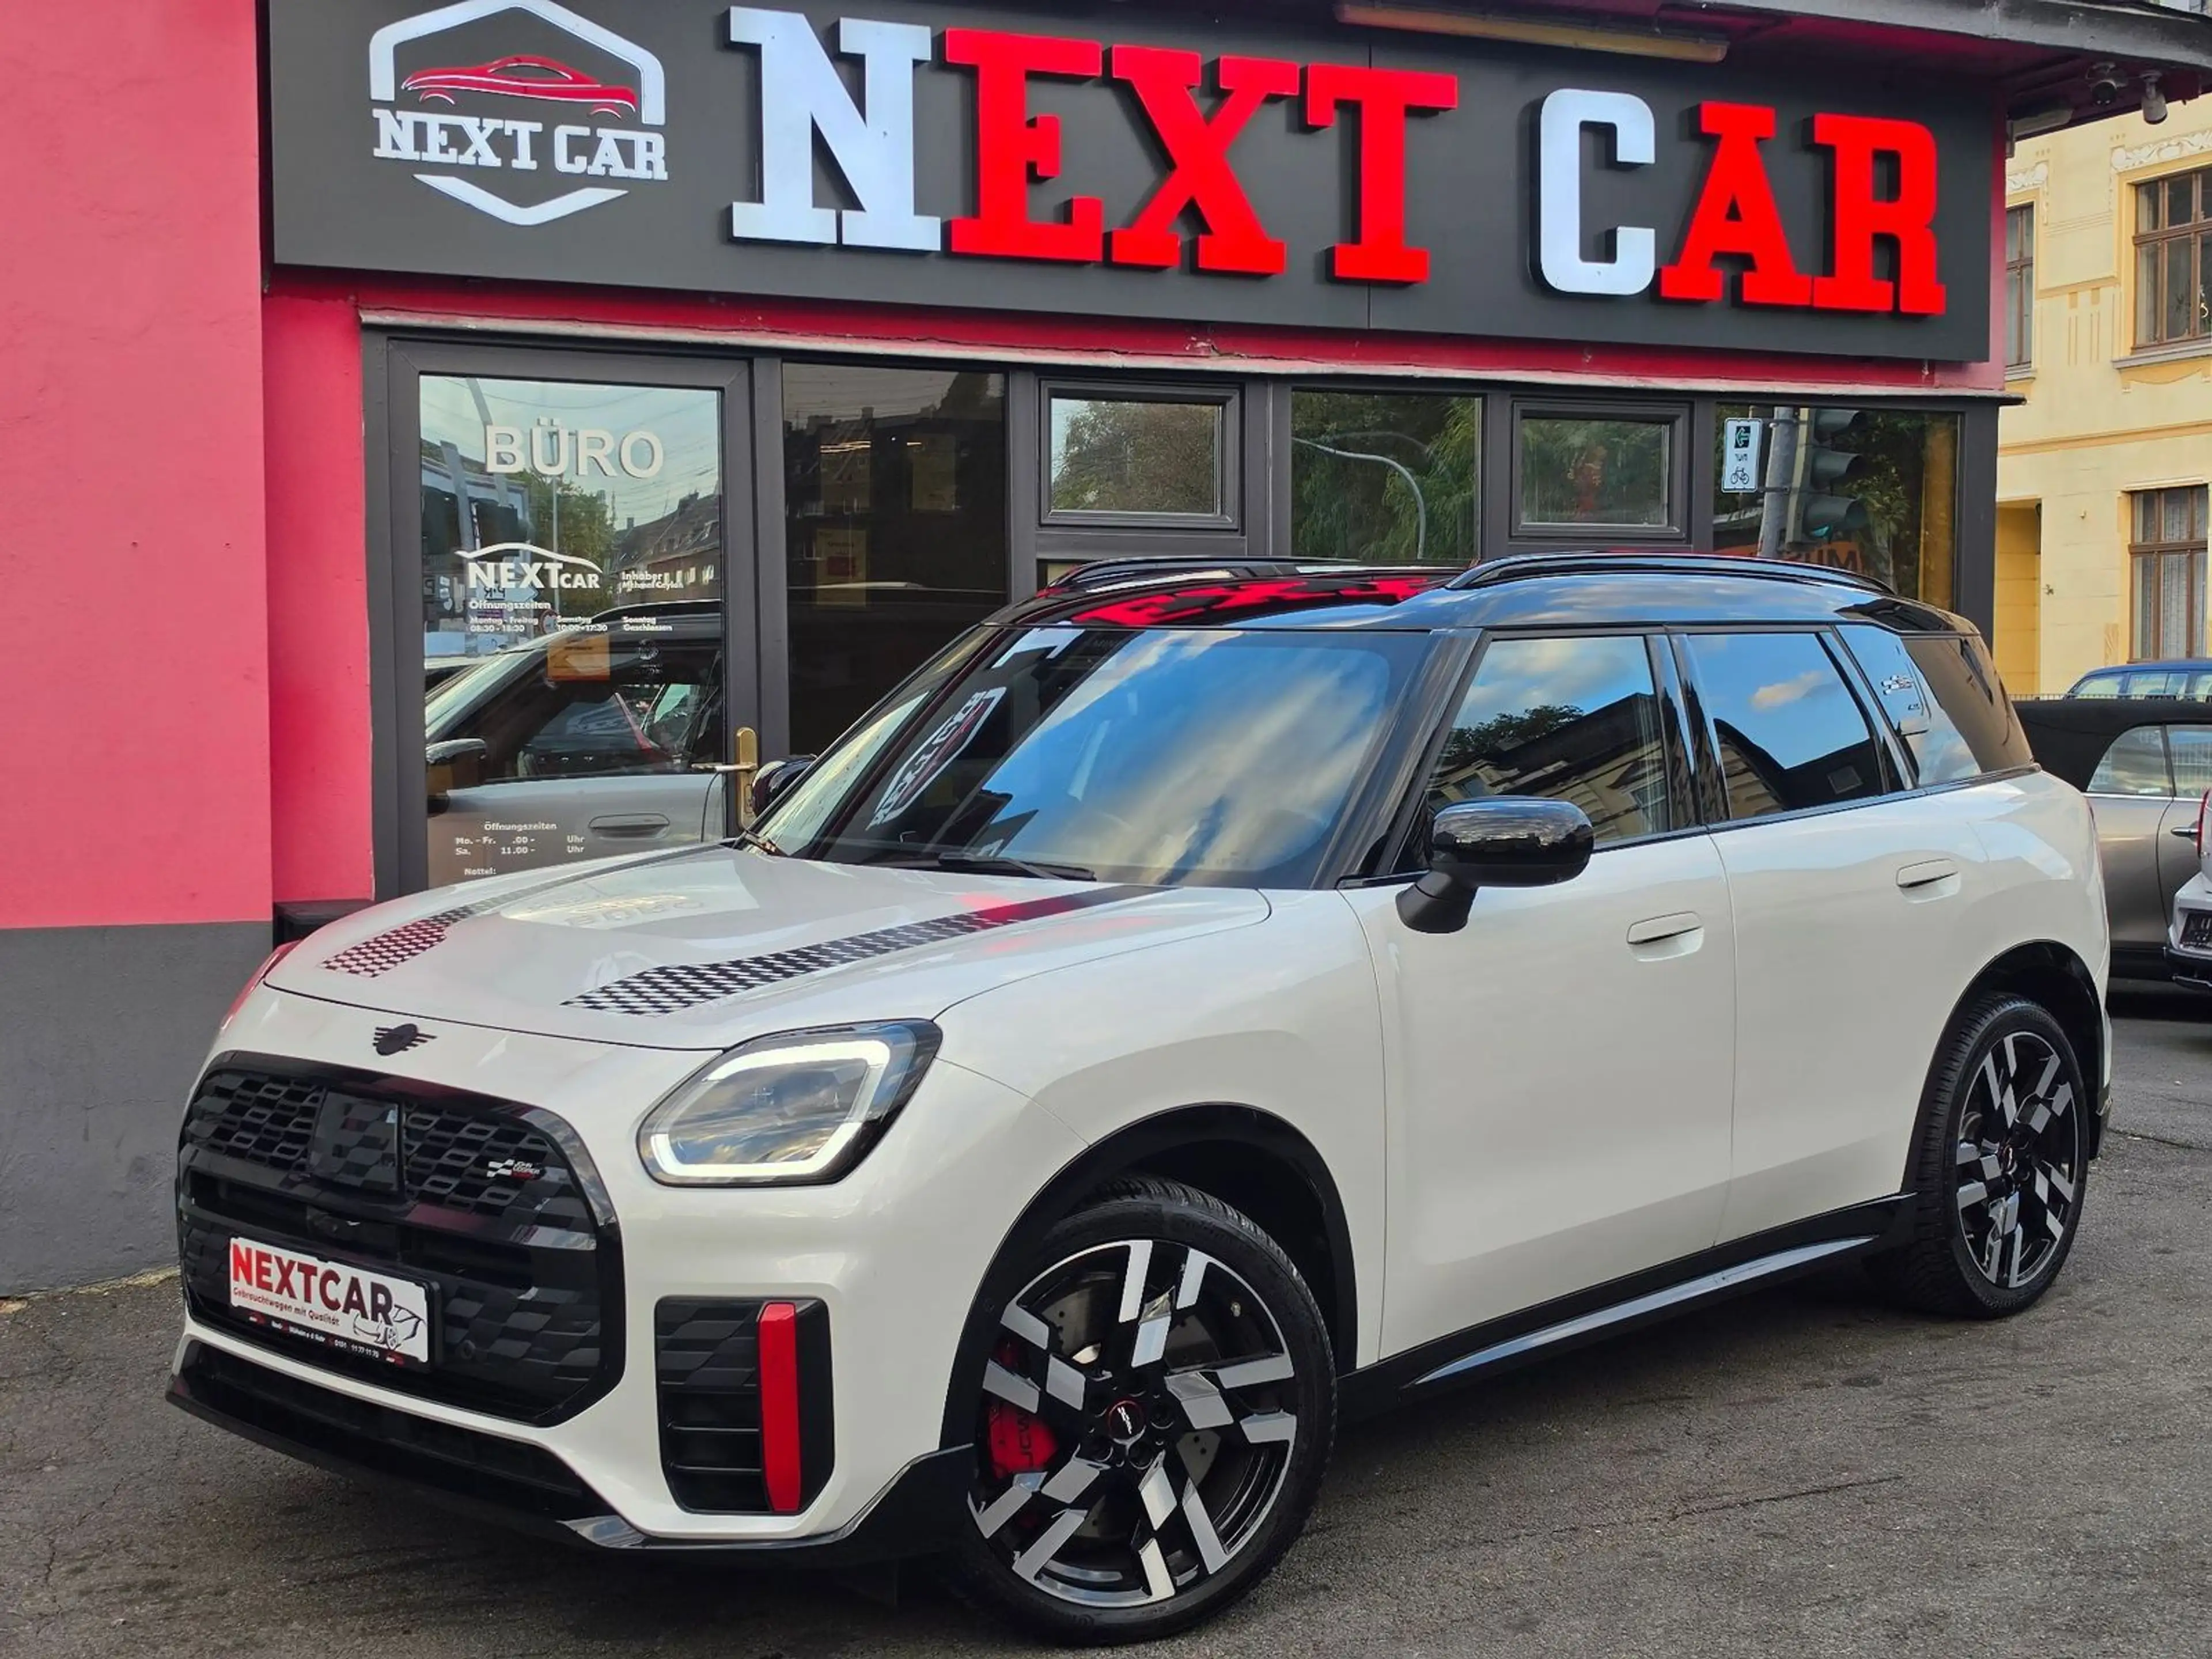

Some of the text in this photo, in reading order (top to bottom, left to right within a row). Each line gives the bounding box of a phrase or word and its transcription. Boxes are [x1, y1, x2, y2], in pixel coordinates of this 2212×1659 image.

[372, 108, 669, 181] NEXT CAR
[729, 5, 1947, 315] NEXT CAR
[486, 416, 664, 479] BÜRO
[622, 570, 662, 580] Inhaber
[469, 599, 551, 612] Öffnungszeiten
[470, 616, 503, 626] Montag
[509, 616, 539, 626] Freitag
[623, 616, 657, 625] Sonntag
[484, 821, 557, 831] Öffnungszeiten
[483, 836, 496, 844] Fr.
[455, 847, 471, 855] Sa.
[232, 1243, 393, 1326] NEXTCAR
[233, 1287, 340, 1326] Gebrauchtwagen mit Qualität
